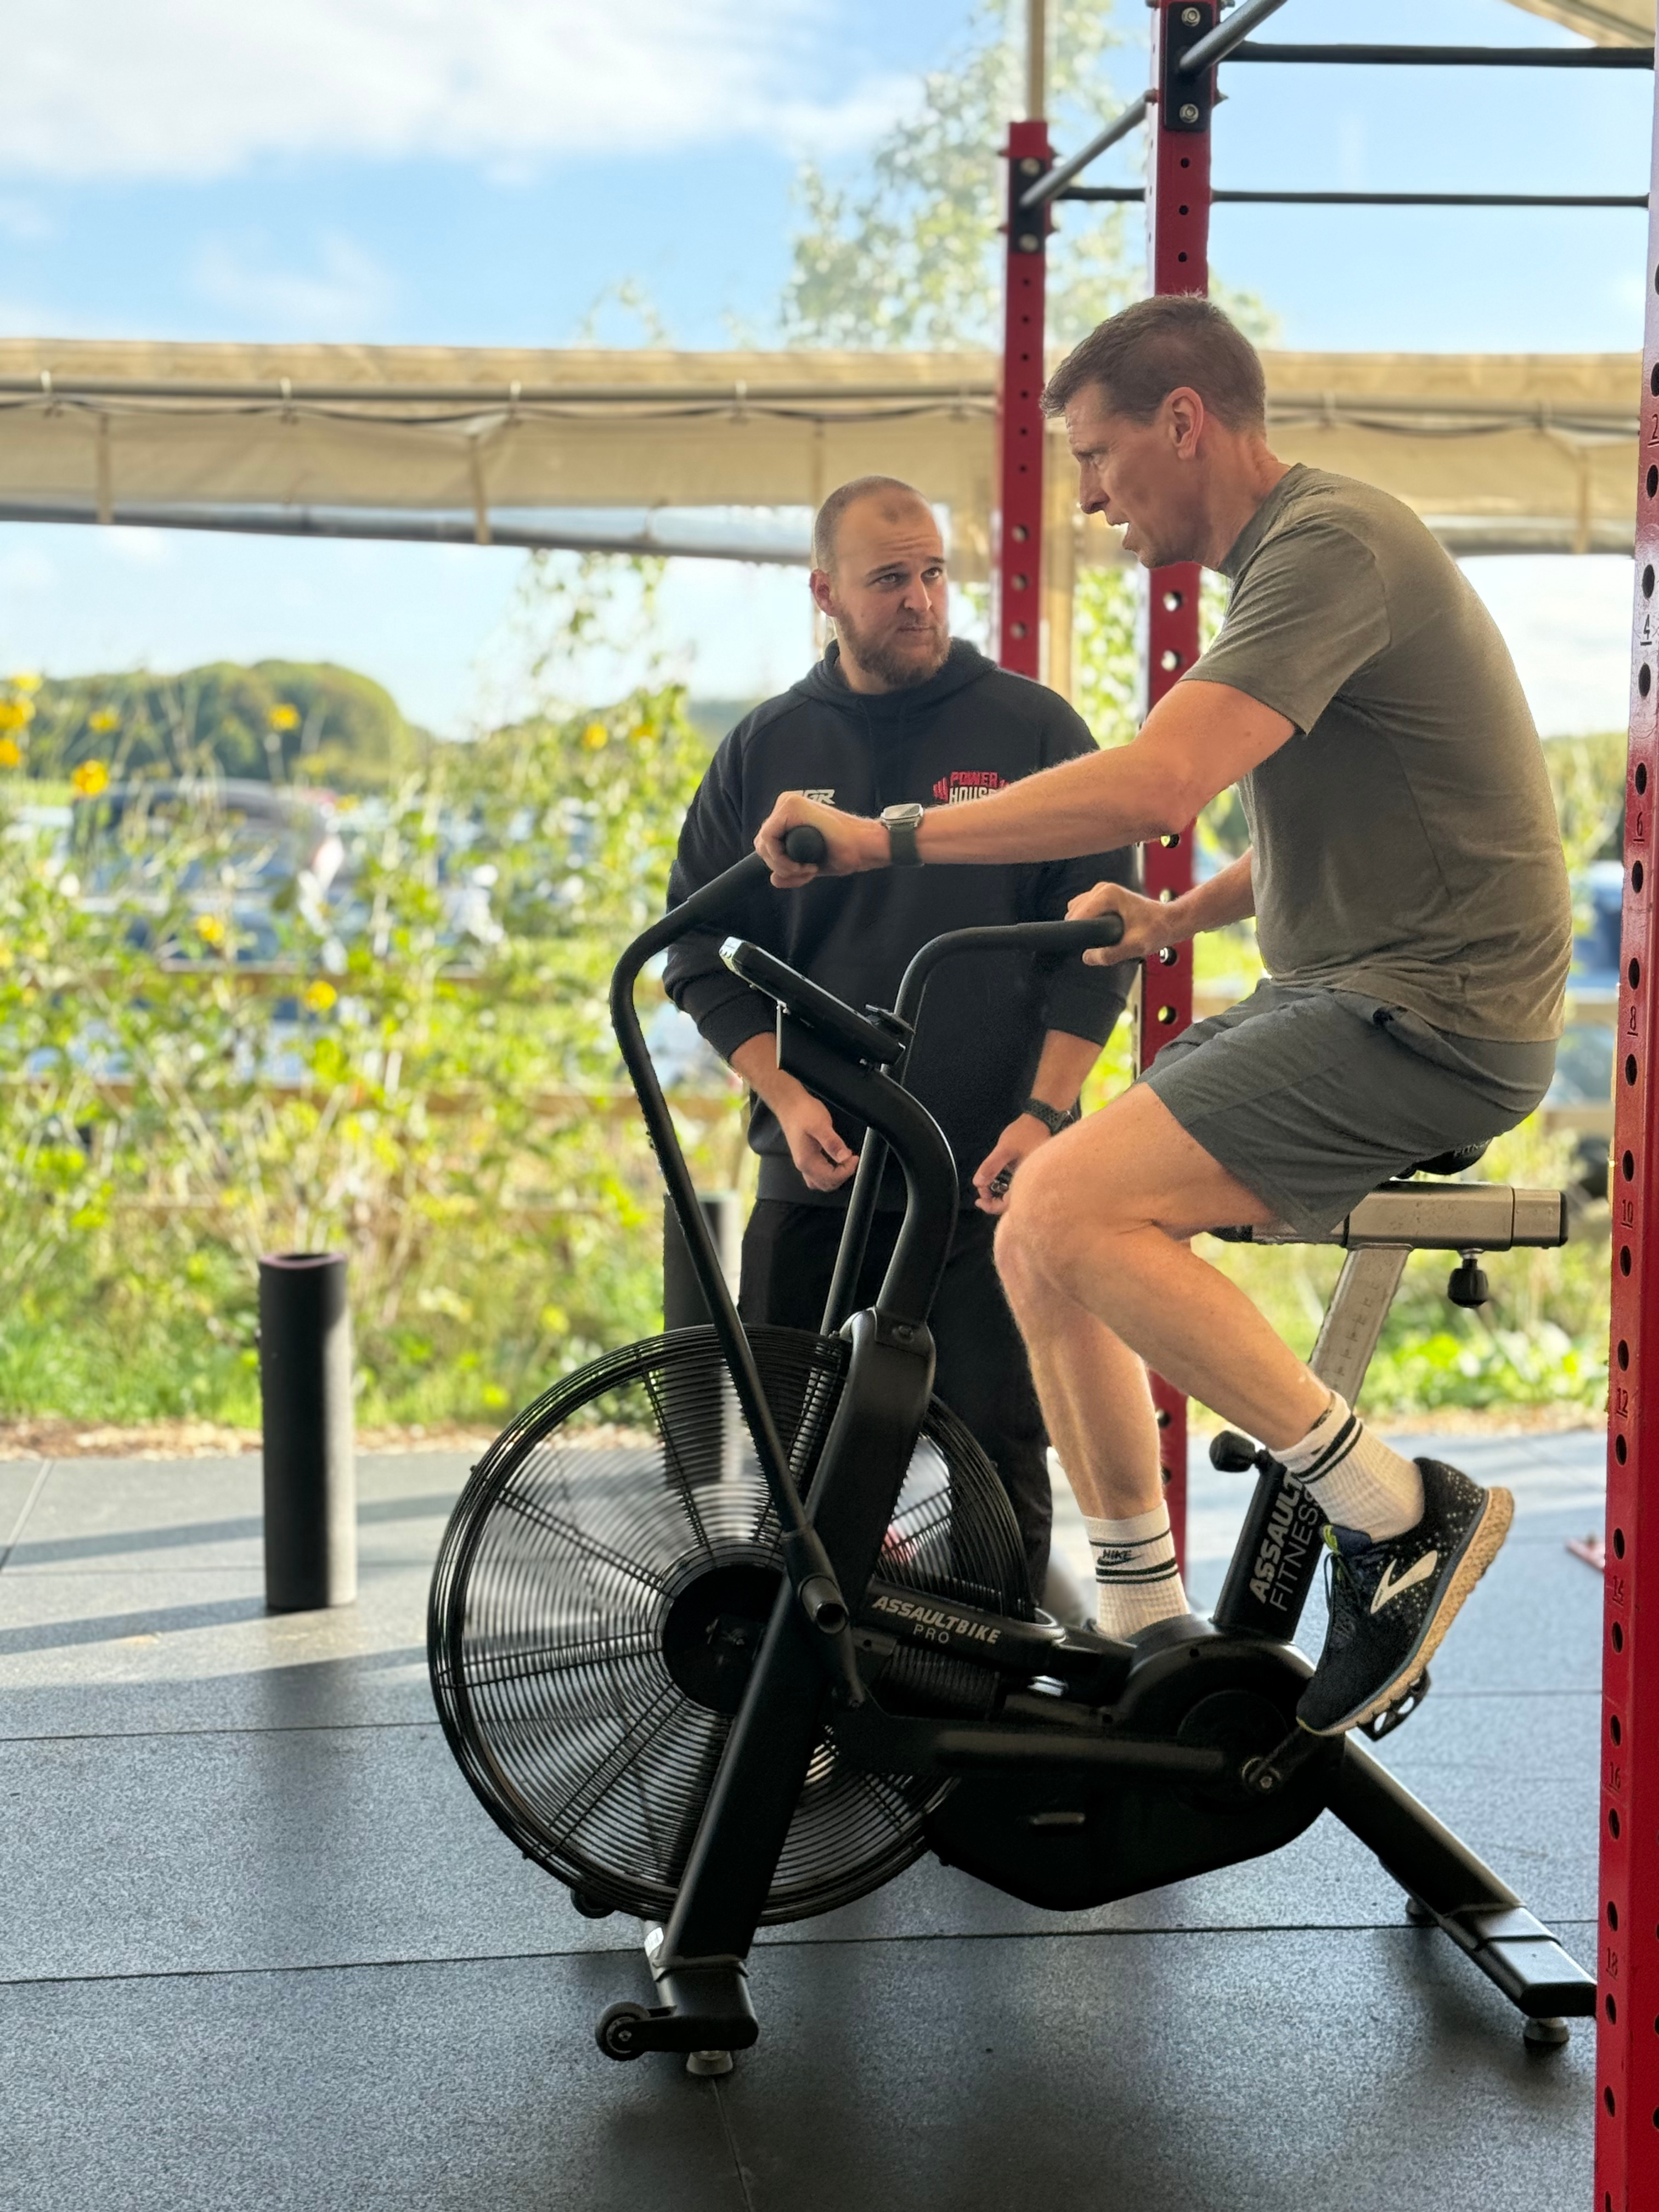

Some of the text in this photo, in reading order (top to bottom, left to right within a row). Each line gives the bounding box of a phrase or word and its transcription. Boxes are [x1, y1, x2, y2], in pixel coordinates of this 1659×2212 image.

[1643, 614, 1650, 640] 4
[950, 771, 998, 788] POWER
[1637, 811, 1643, 837] 6
[1629, 1005, 1637, 1031] 8
[1622, 1199, 1633, 1223] 10
[1617, 1387, 1628, 1413] 12
[1249, 1470, 1304, 1604] ASSAULT
[1102, 1549, 1132, 1559] NIKE
[872, 1595, 1001, 1645] ASSAULTBIKE
[913, 1624, 950, 1644] PRO
[1610, 1761, 1621, 1789] 16
[1607, 1947, 1618, 1976] 18
